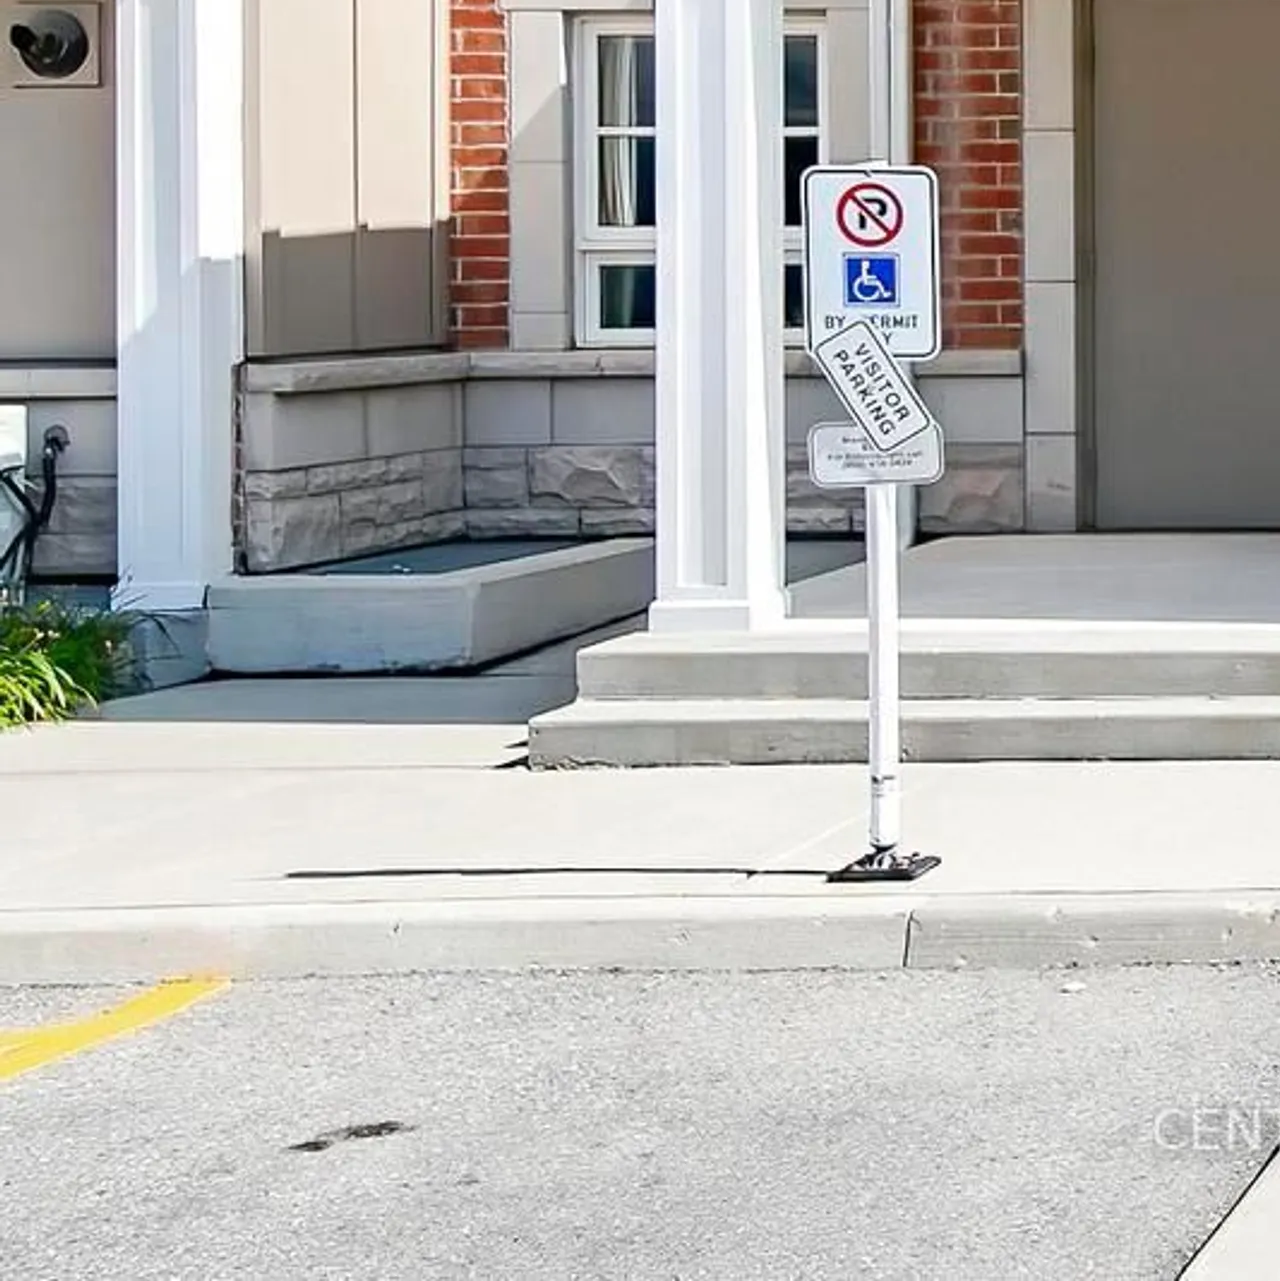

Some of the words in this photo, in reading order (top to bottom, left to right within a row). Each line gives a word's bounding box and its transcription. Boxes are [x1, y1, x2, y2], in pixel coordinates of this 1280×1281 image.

[858, 197, 888, 230] P
[825, 315, 846, 329] BY
[866, 314, 918, 330] ERMIT
[833, 349, 897, 436] PARKING
[855, 342, 911, 422] VISITOR
